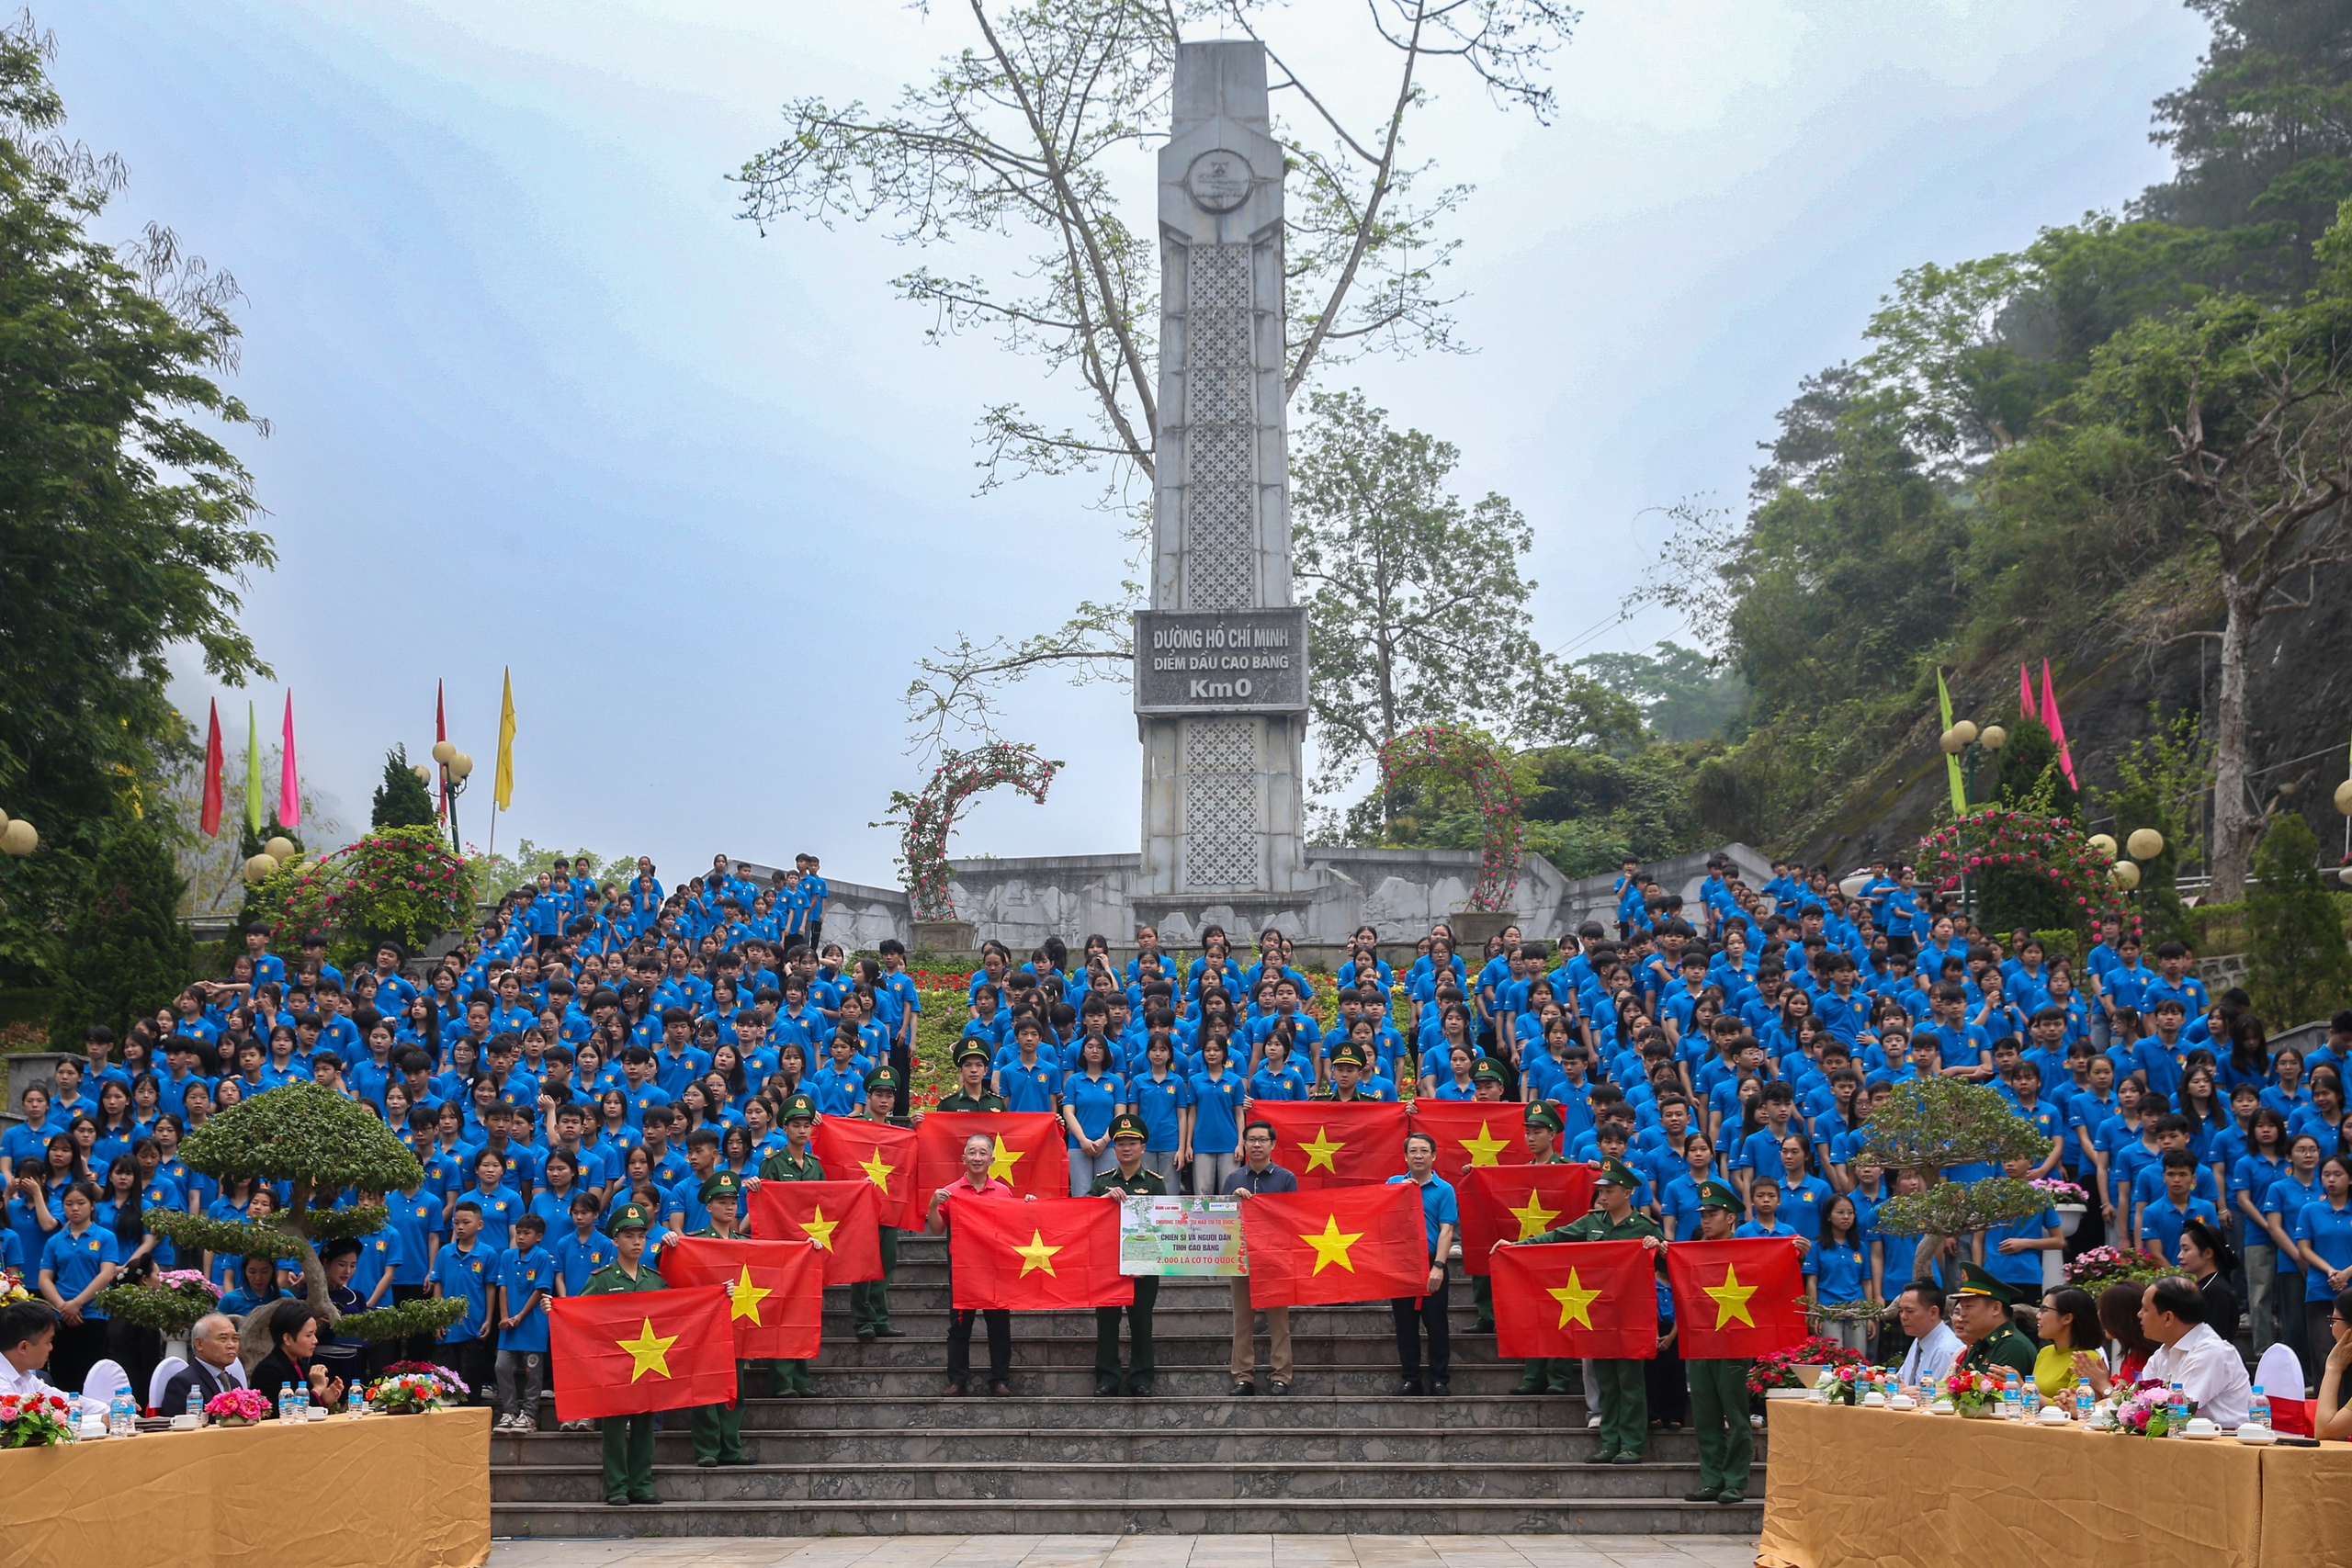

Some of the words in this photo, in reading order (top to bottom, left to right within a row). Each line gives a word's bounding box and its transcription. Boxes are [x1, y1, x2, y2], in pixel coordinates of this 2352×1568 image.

[1153, 625, 1202, 649] ĐƯỜNG
[1206, 621, 1225, 648] HỒ
[1228, 624, 1251, 648] CHÍ
[1254, 628, 1288, 648] MINH
[1154, 649, 1185, 670] ĐIỂM
[1190, 650, 1217, 671] ĐẦU
[1221, 656, 1249, 670] CAO
[1252, 648, 1288, 669] BẰNG
[1157, 1256, 1179, 1264] 2.000
